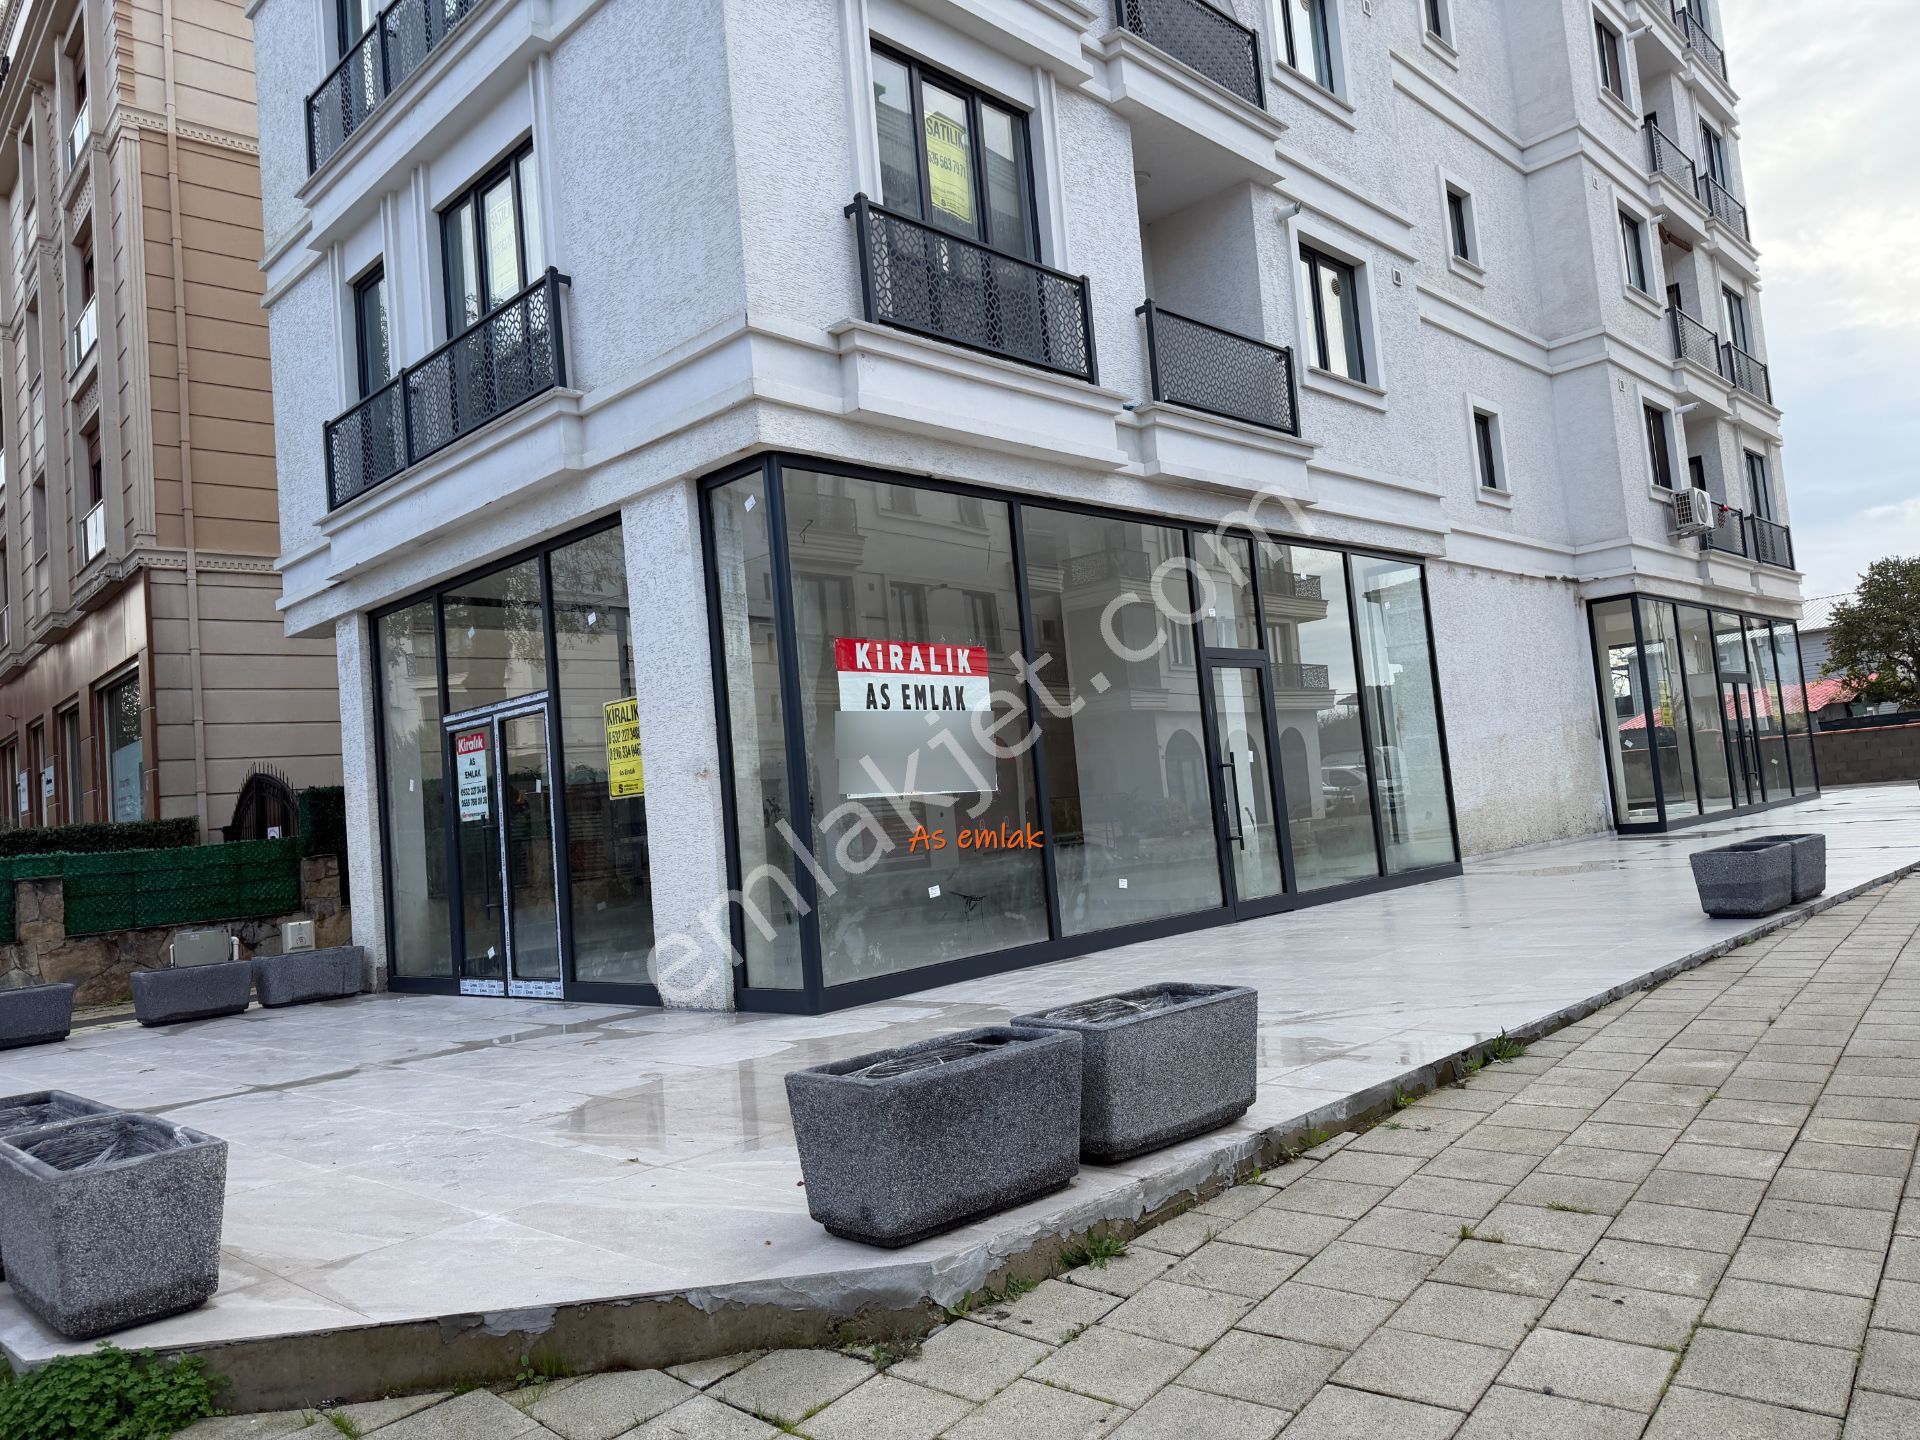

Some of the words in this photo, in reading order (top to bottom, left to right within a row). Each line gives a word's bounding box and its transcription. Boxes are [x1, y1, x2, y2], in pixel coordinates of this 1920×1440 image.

[866, 683, 891, 710] AS
[901, 684, 967, 711] EMLAK
[606, 703, 640, 726] KİRALIK
[612, 729, 621, 744] 532
[621, 728, 630, 742] 227
[622, 745, 631, 759] 334
[469, 758, 476, 766] AS
[464, 769, 481, 779] EMLAK
